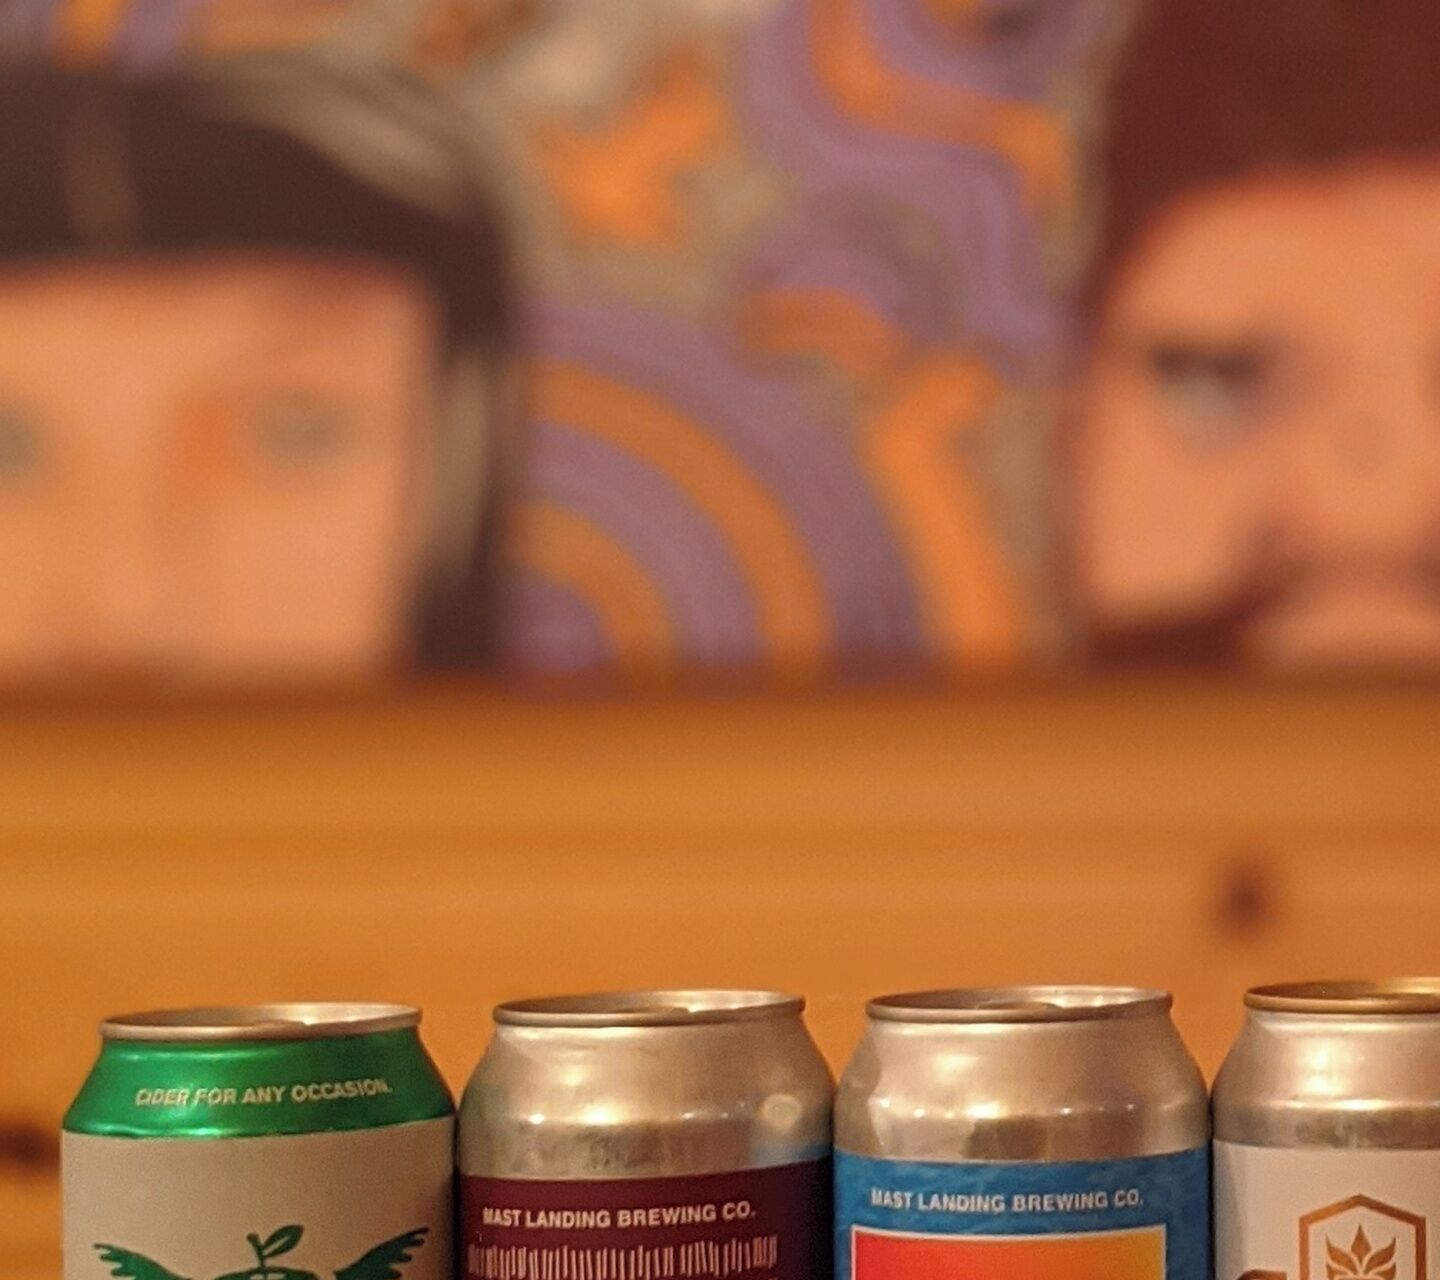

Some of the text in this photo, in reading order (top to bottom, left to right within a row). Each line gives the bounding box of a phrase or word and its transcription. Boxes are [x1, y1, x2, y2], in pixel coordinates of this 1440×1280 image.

[134, 1088, 189, 1106] CIDER
[194, 1088, 236, 1106] FOR
[242, 1085, 286, 1105] ANY
[917, 1192, 1005, 1213] LANDING
[1011, 1189, 1107, 1213] BREWING
[1114, 1188, 1144, 1208] CO.
[525, 1209, 611, 1229] LANDING
[617, 1204, 717, 1228] BREWING
[722, 1200, 756, 1221] CO.
